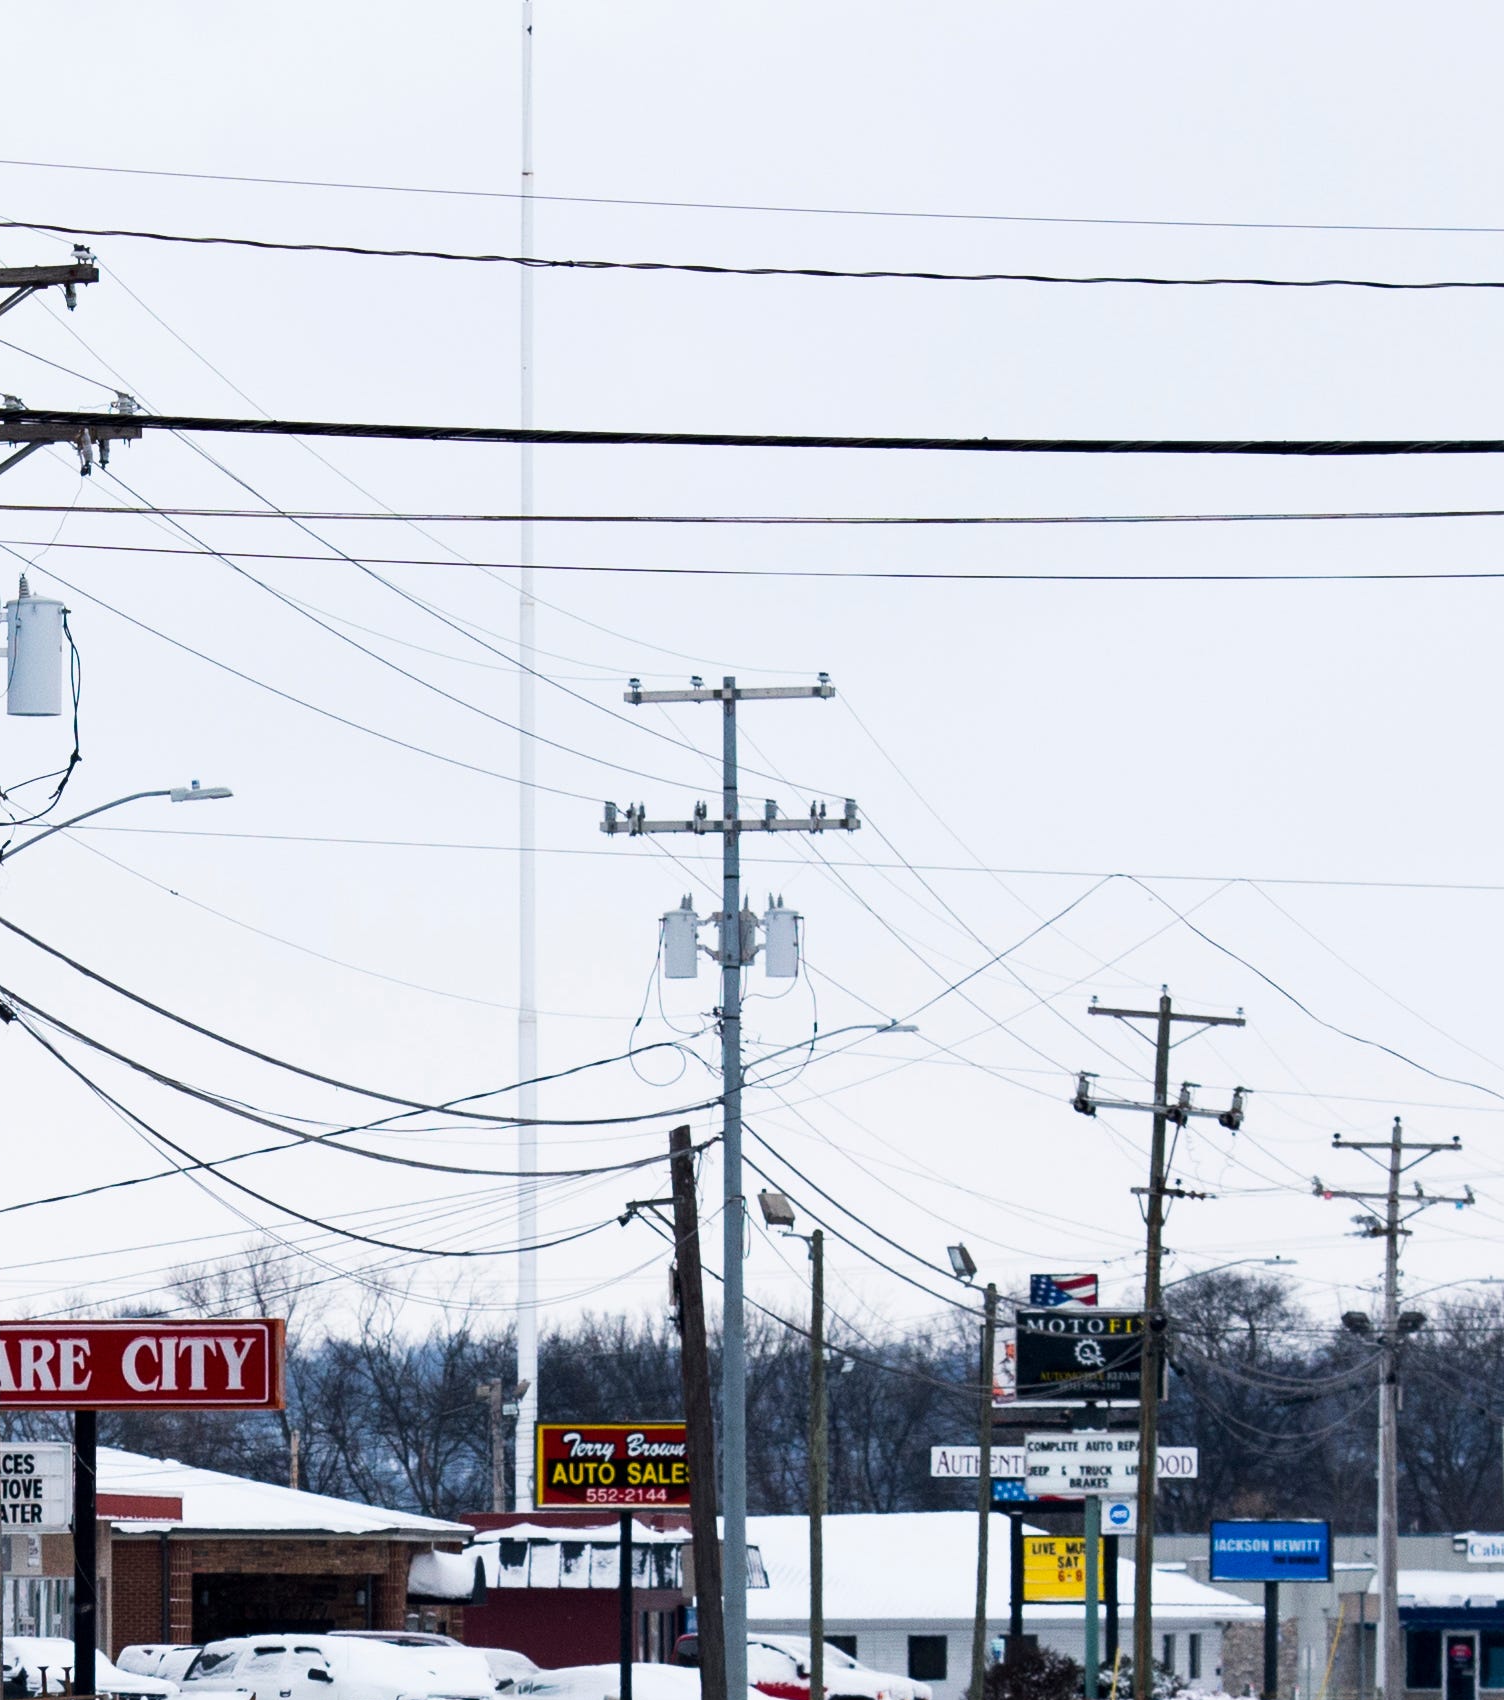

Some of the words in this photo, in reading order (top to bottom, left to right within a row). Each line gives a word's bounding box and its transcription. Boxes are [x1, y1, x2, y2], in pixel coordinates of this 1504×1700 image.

[121, 1337, 256, 1393] CITY
[562, 1432, 615, 1462] Terry
[626, 1433, 687, 1457] Brown
[1027, 1441, 1079, 1452] COMPLETE
[1085, 1441, 1113, 1452] AUTO
[552, 1463, 616, 1484] AUTO
[1080, 1465, 1113, 1476] TRUCK
[0, 1479, 42, 1499] TOVE
[1069, 1478, 1109, 1489] BRAKES
[586, 1488, 667, 1502] 552-2144
[1032, 1542, 1056, 1555] LIVE
[1214, 1538, 1270, 1553] JACKSON
[1273, 1538, 1321, 1553] HEWITT
[1058, 1557, 1079, 1569] SAT
